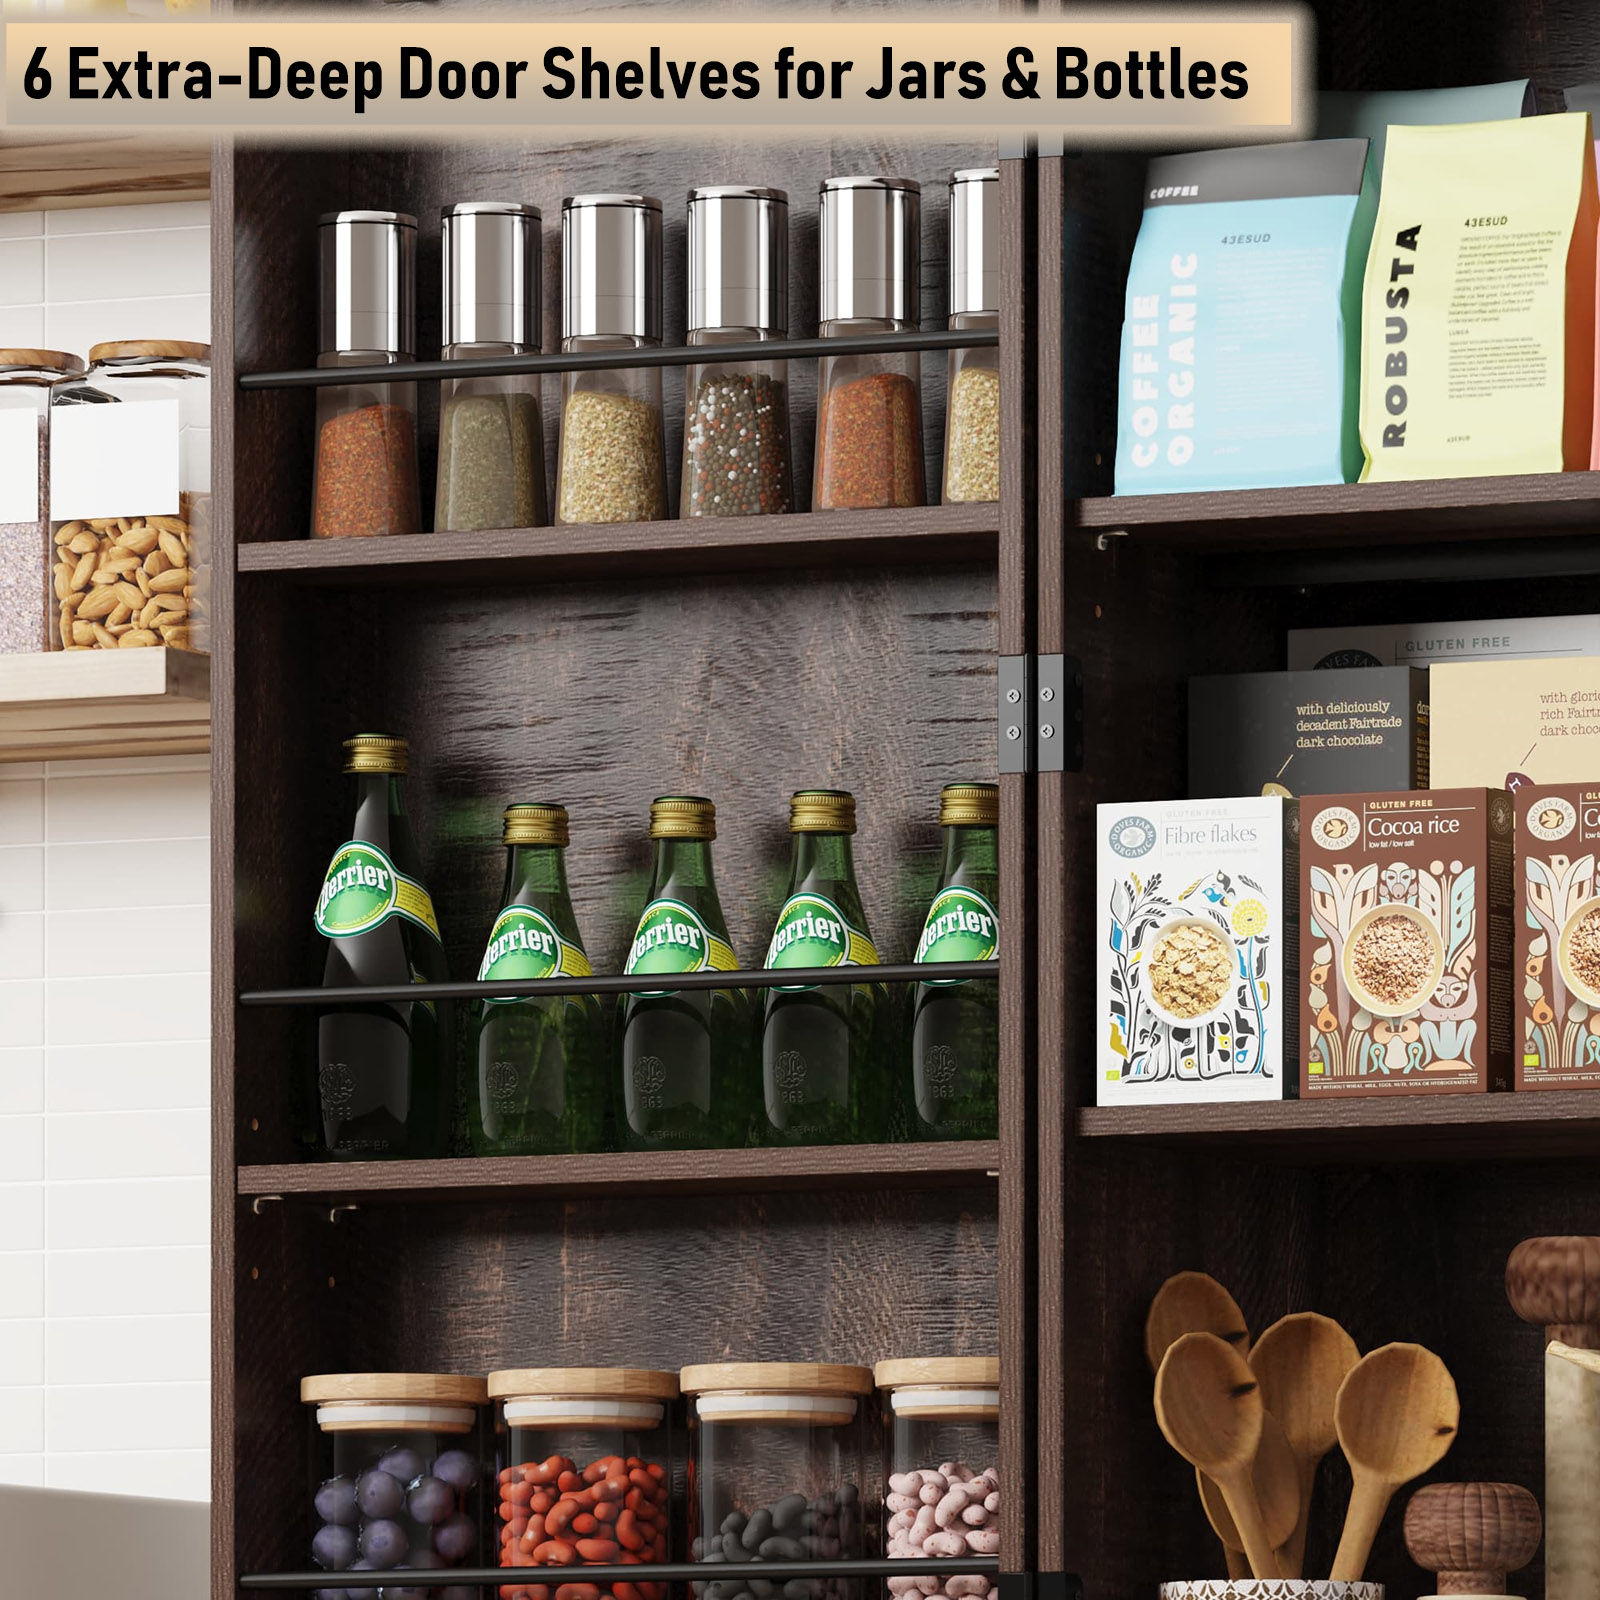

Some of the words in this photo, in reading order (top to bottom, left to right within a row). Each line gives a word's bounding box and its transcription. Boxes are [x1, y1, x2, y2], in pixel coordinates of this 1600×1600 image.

[1150, 185, 1199, 199] COFFEE
[1464, 216, 1508, 228] 43ESUD
[1221, 233, 1271, 245] 43ESUD
[1382, 224, 1422, 448] ROBUSTA
[1167, 253, 1198, 466] ORGANIC
[1131, 294, 1160, 468] COFFEE
[1406, 638, 1465, 652] GLUTEN
[1472, 636, 1511, 648] FREE
[1539, 692, 1567, 704] with
[1570, 689, 1600, 704] glori
[1296, 703, 1324, 715] with
[1326, 700, 1391, 714] deliciously
[1539, 709, 1564, 720] rich
[1296, 718, 1348, 732] decadent
[1348, 716, 1402, 729] Fairtrade
[1539, 725, 1568, 737] dark
[1571, 724, 1600, 735] choc
[1296, 736, 1325, 748] dark
[1326, 733, 1384, 746] chocolate
[1586, 792, 1600, 800] GL
[1369, 801, 1406, 810] GLUTEN
[1409, 799, 1433, 807] FREE
[1111, 817, 1134, 840] DOVES
[1135, 818, 1154, 840] FARM
[1368, 817, 1423, 836] Cocoa
[1428, 815, 1460, 834] rice
[1165, 826, 1206, 845] Fibre
[1211, 823, 1257, 843] flakes
[1114, 840, 1154, 857] ORGANIC
